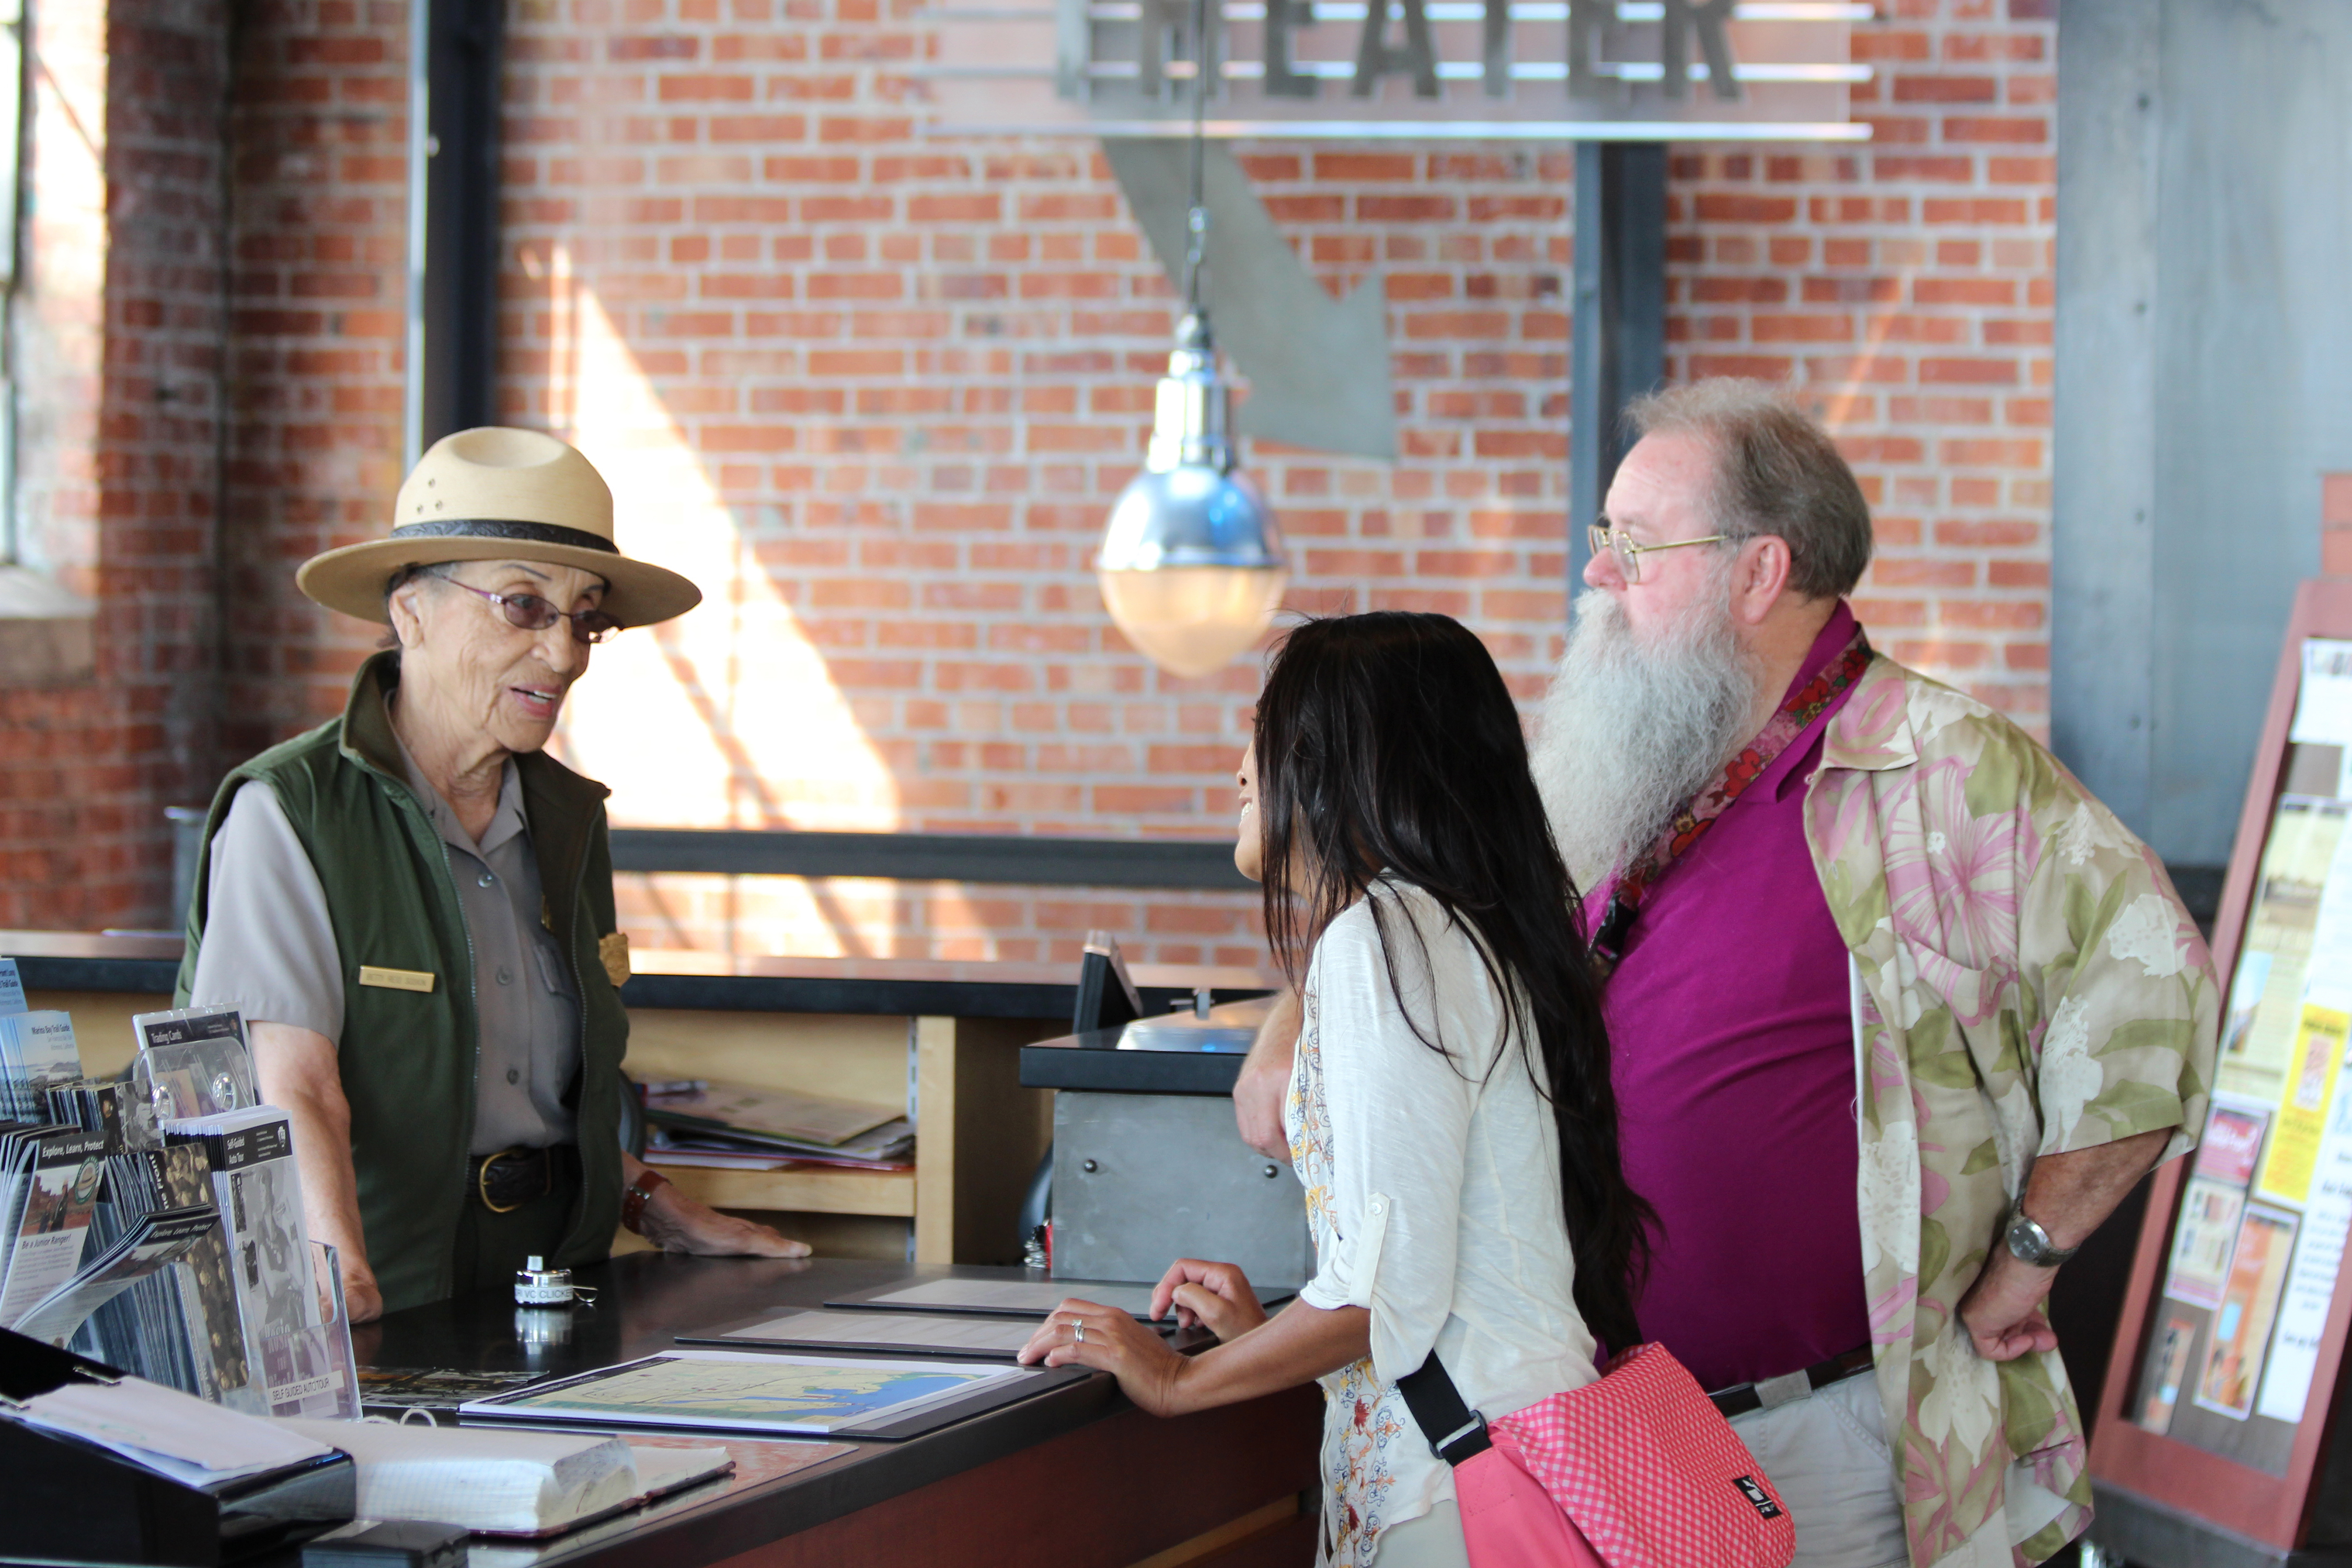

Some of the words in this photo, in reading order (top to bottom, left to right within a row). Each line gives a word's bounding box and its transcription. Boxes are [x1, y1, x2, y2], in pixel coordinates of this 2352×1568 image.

[151, 1031, 170, 1044] Trading
[42, 1145, 65, 1159] Explore,
[65, 1144, 83, 1154] Learn,
[84, 1139, 105, 1152] Protect
[22, 1241, 29, 1250] Be
[33, 1239, 51, 1248] Junior
[51, 1233, 72, 1247] Ranger!
[272, 1389, 284, 1401] SELF
[284, 1385, 303, 1398] GUIDED
[304, 1381, 317, 1393] AUTO
[316, 1377, 330, 1389] TOUR
